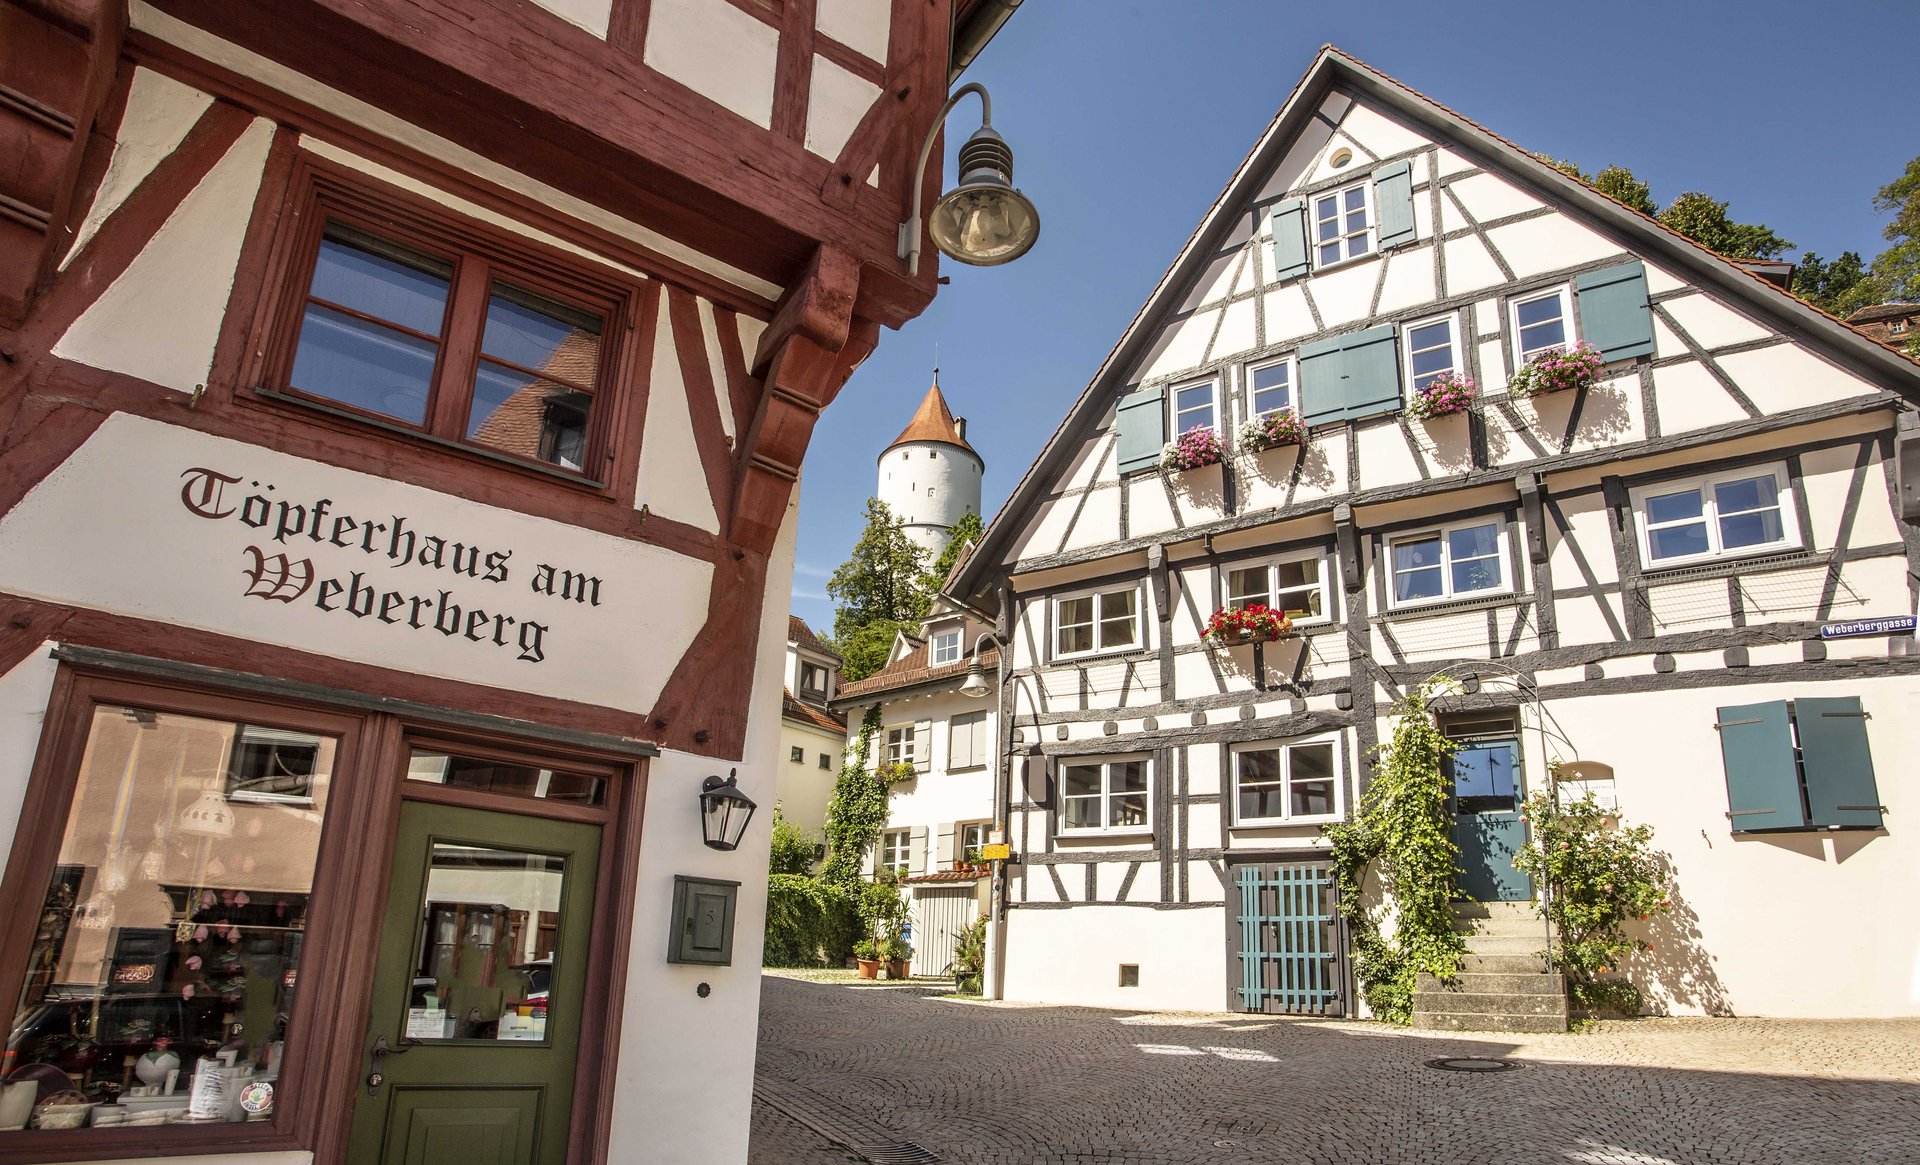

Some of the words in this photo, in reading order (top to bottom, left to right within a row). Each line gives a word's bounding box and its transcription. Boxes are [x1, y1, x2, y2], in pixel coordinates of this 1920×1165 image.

[181, 467, 512, 583] Töpferhaus
[531, 560, 604, 606] am
[242, 544, 549, 664] Weberberg
[1825, 618, 1913, 635] Weberberggasse
[705, 910, 714, 925] 5
